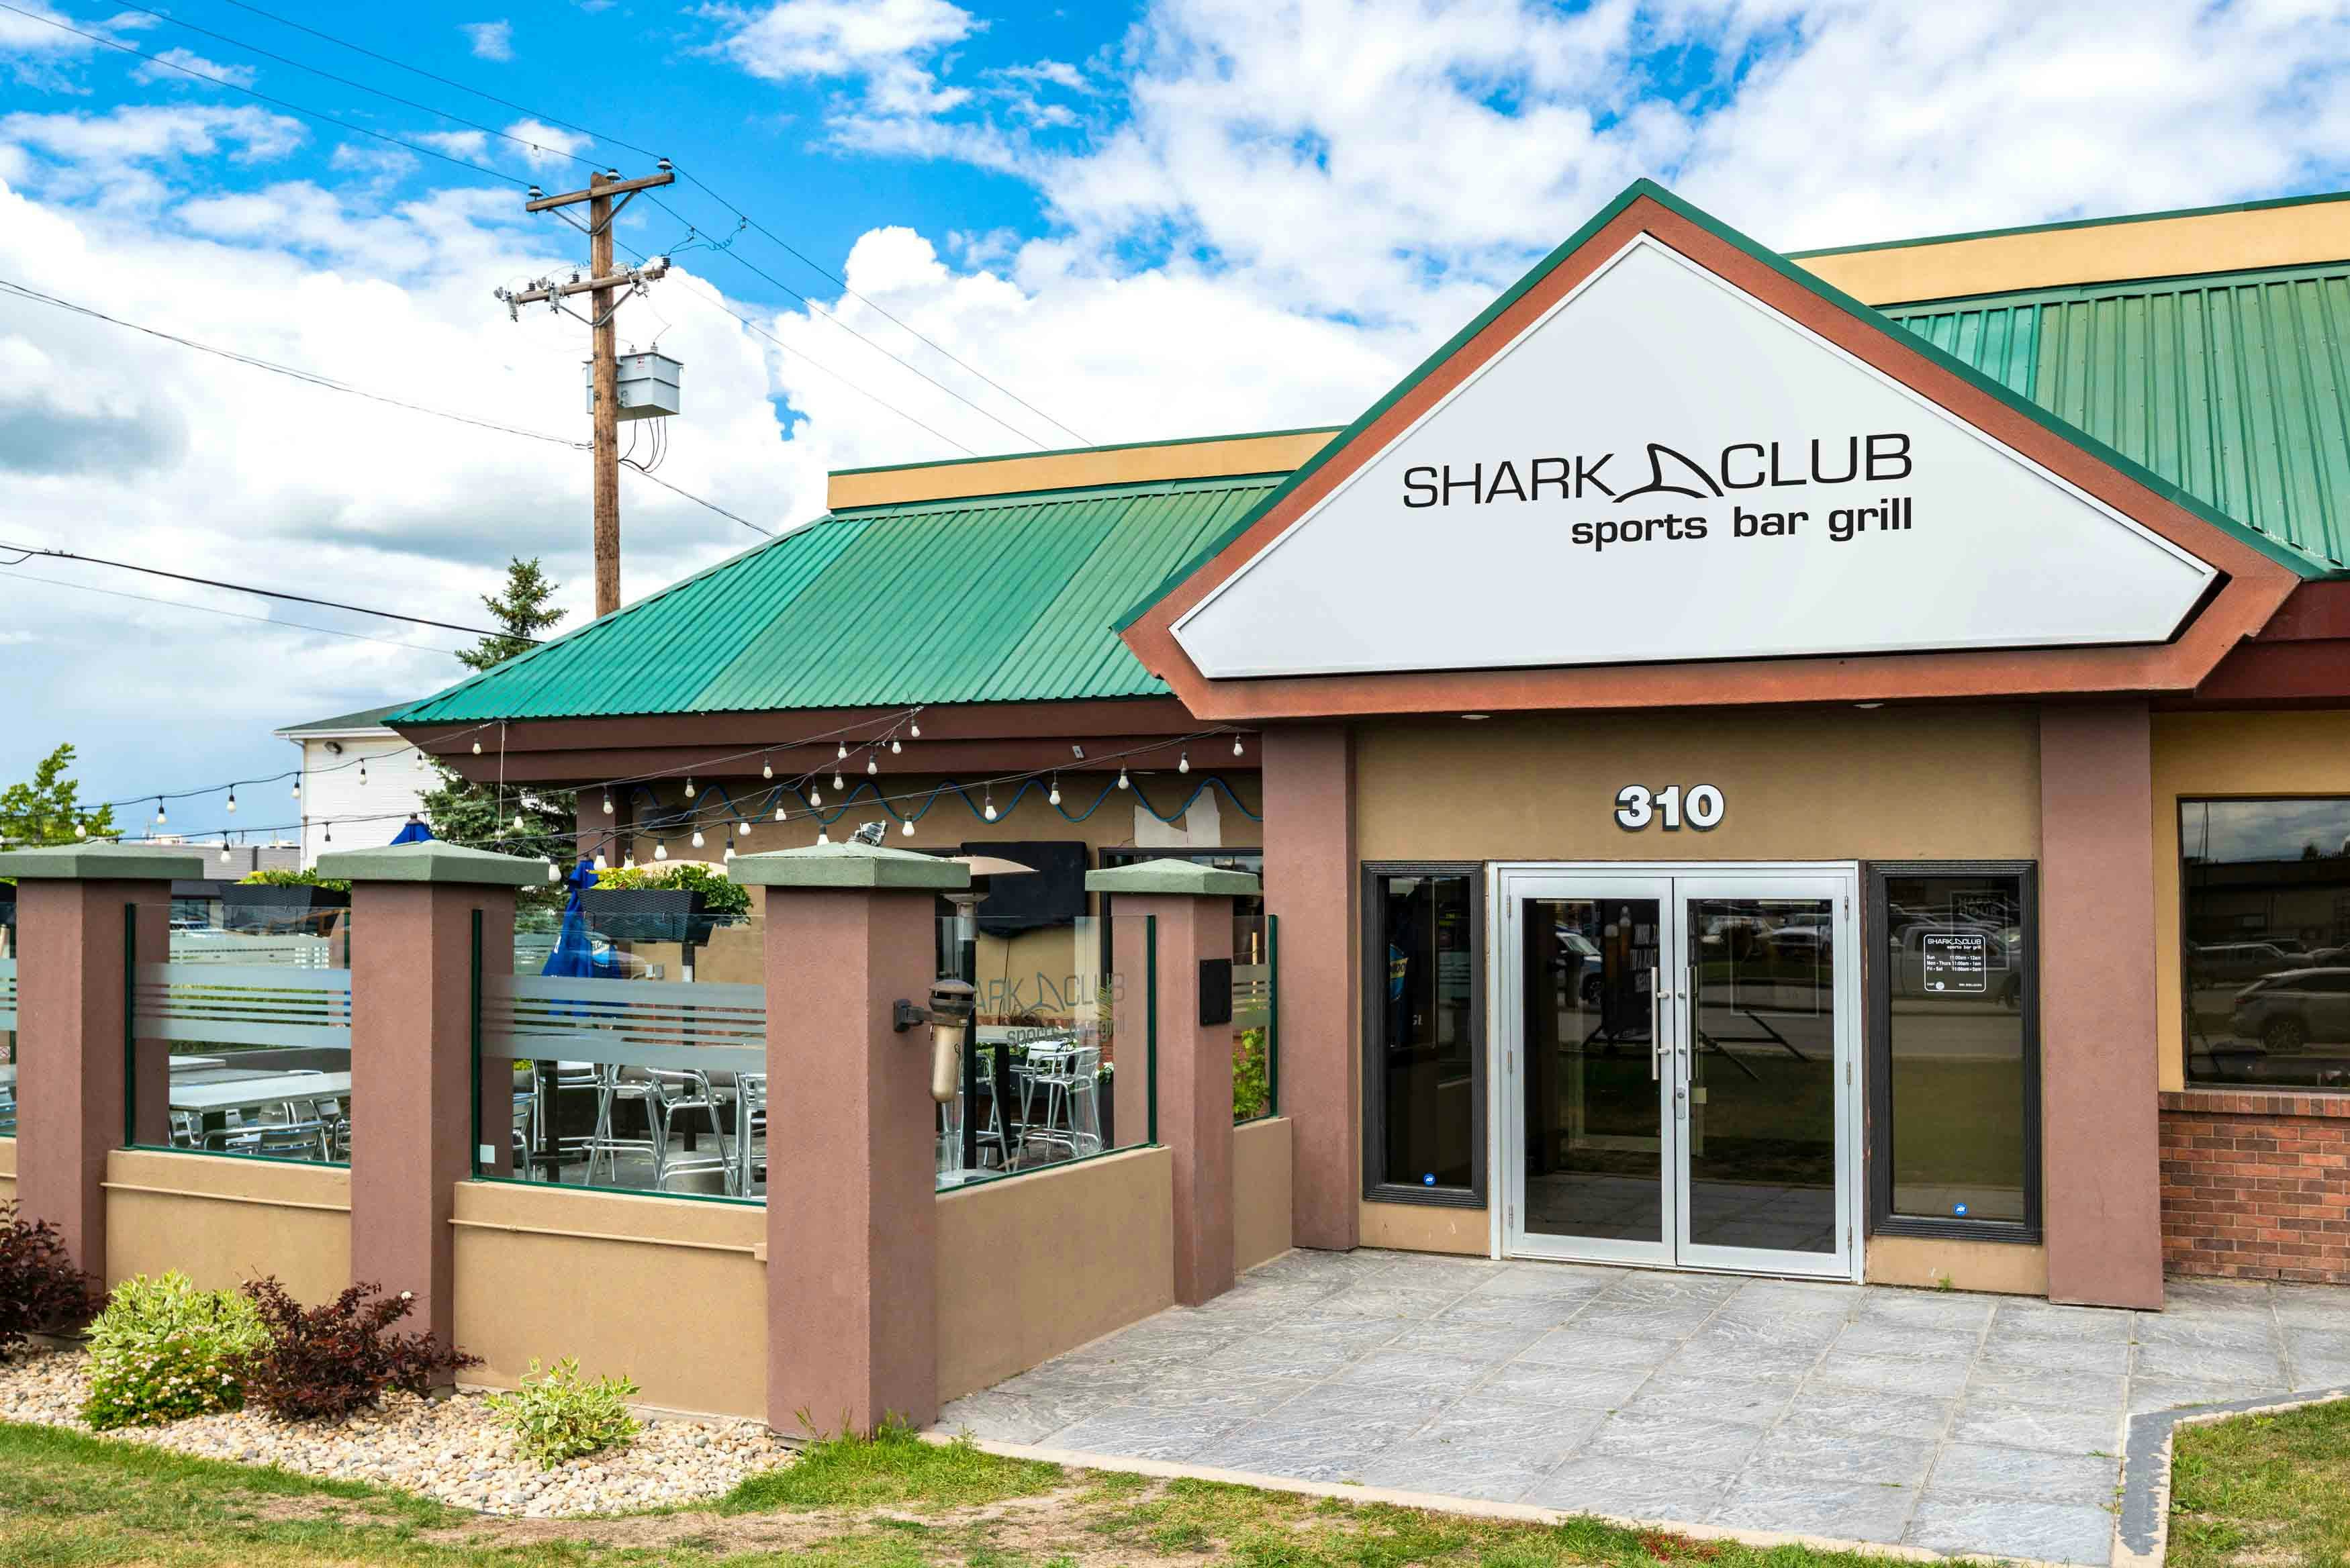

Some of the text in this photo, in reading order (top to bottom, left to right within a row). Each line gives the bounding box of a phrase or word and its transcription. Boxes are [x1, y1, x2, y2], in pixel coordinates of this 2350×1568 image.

[1403, 433, 1913, 509] SHARK CLUB
[1572, 497, 1912, 552] sports bar grill
[1614, 783, 1726, 831] 310
[1064, 973, 1125, 1007] CLUB
